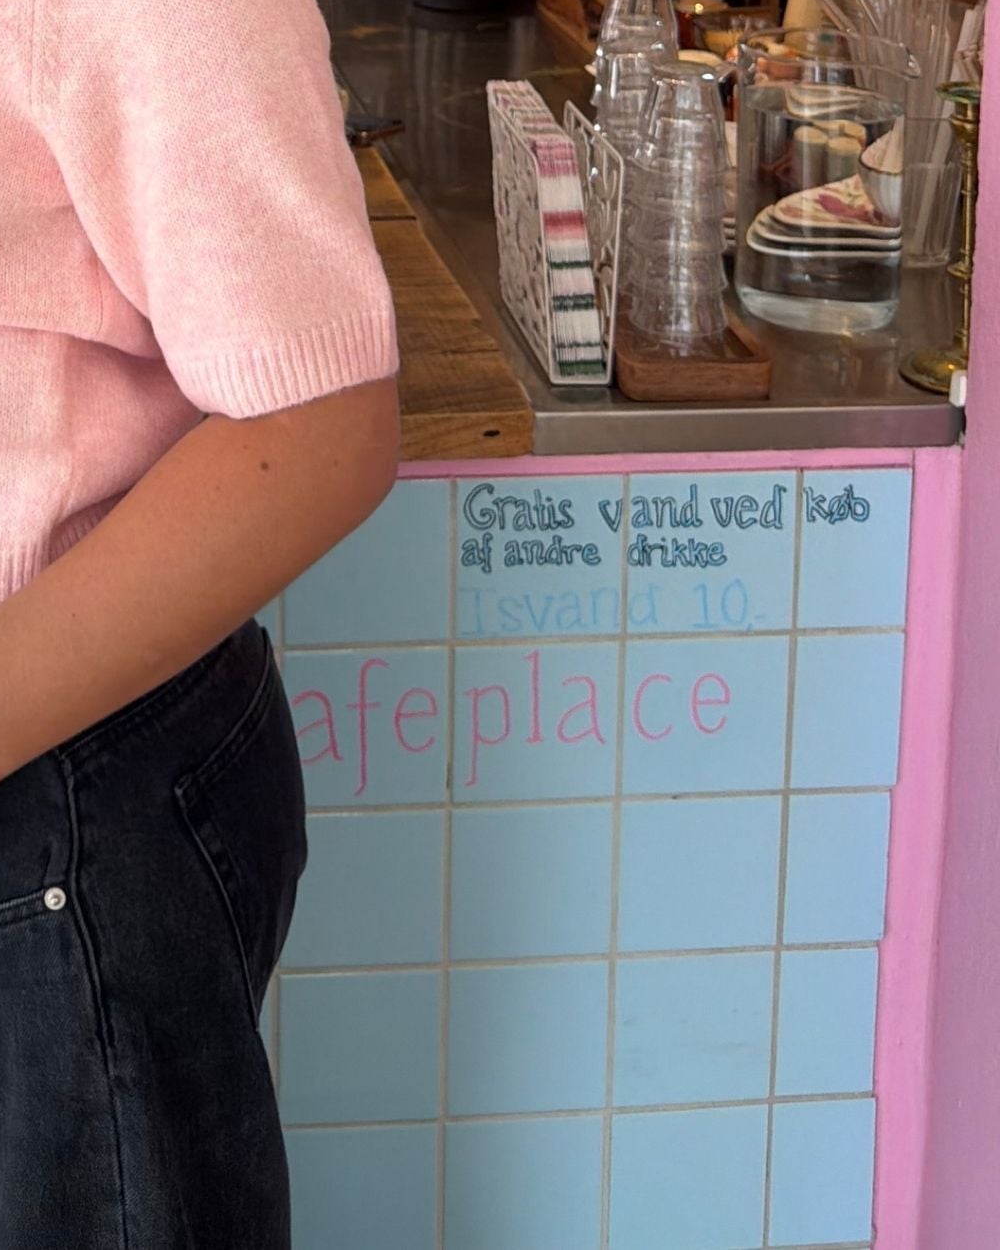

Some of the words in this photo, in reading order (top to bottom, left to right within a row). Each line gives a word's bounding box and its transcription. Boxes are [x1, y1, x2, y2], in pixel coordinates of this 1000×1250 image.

[463, 483, 574, 531] Gratis
[598, 484, 703, 532] vand
[710, 484, 787, 529] ved
[803, 484, 870, 524] køb
[461, 532, 493, 574] af
[504, 535, 601, 567] andre
[627, 533, 727, 568] drikke
[457, 583, 663, 637] Isvand
[291, 650, 731, 796] afeplace
